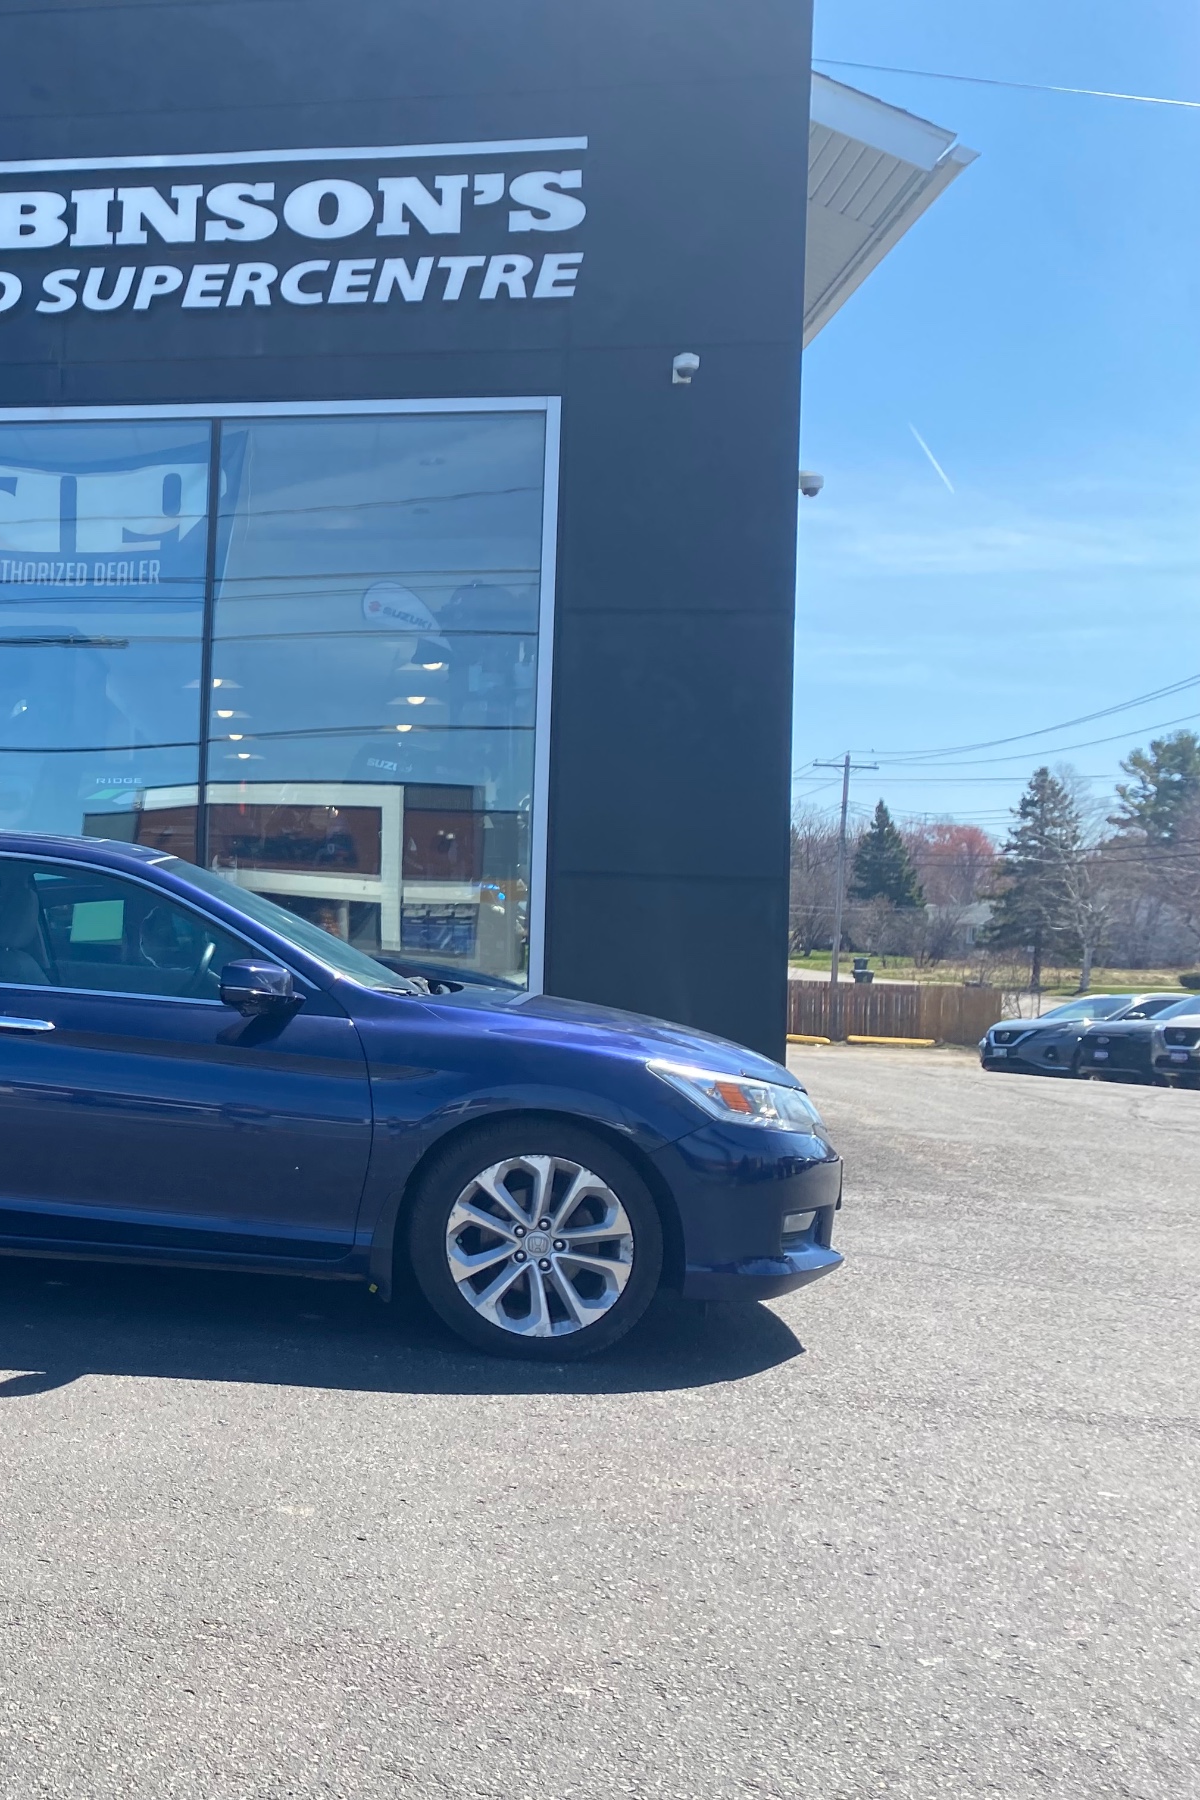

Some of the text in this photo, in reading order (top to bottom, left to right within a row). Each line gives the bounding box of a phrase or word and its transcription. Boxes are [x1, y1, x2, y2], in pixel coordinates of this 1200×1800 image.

[35, 251, 585, 313] SUPERCENTRE
[94, 560, 160, 587] DEALER
[382, 605, 433, 631] SUZUKI
